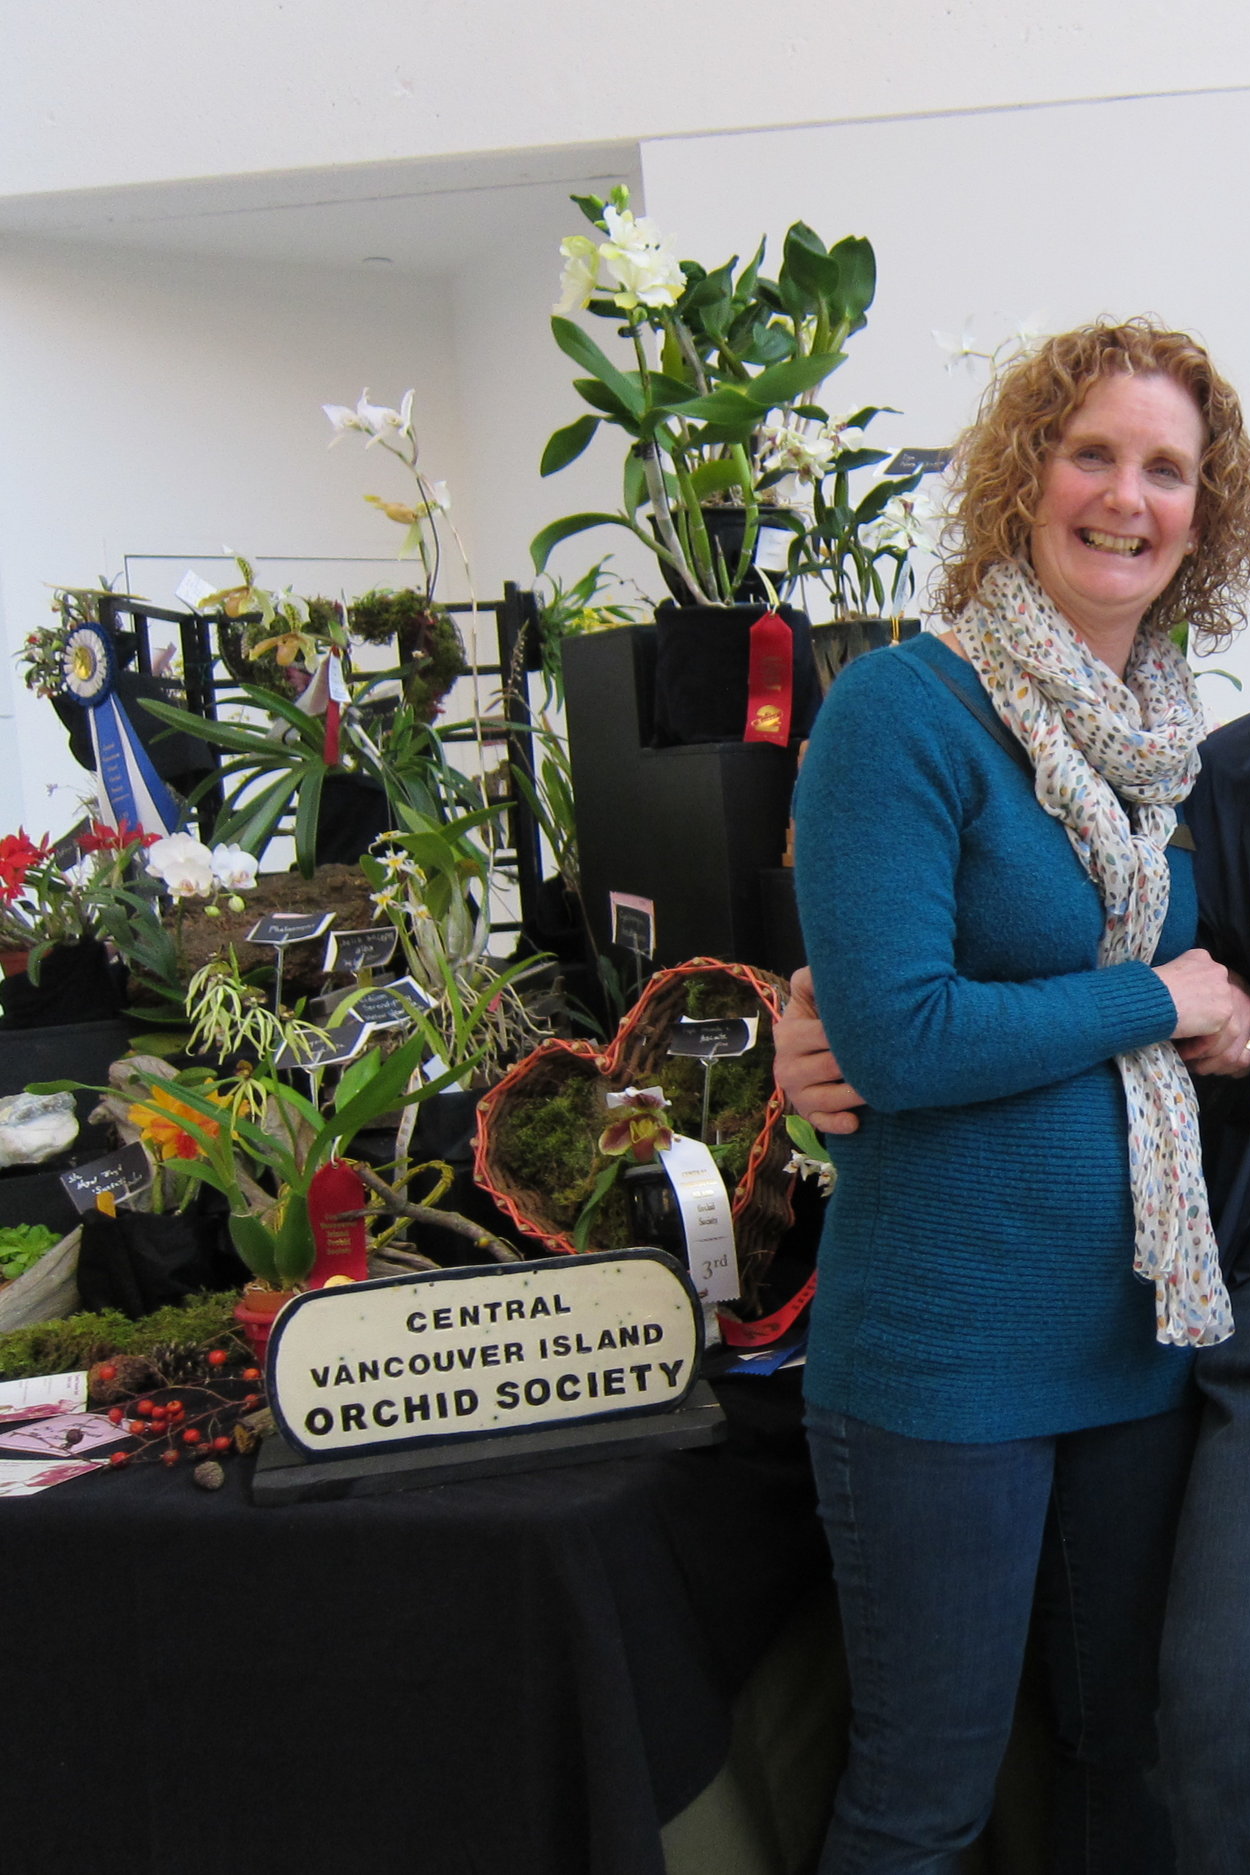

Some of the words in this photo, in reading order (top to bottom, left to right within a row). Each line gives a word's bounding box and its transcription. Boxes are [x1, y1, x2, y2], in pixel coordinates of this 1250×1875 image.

[702, 1254, 729, 1281] 3rd
[406, 1294, 571, 1333] CENTRAL
[309, 1341, 525, 1388] VANCOUVER
[539, 1323, 664, 1360] ISLAND
[304, 1388, 479, 1436] ORCHID
[496, 1359, 685, 1409] SOCIETY
